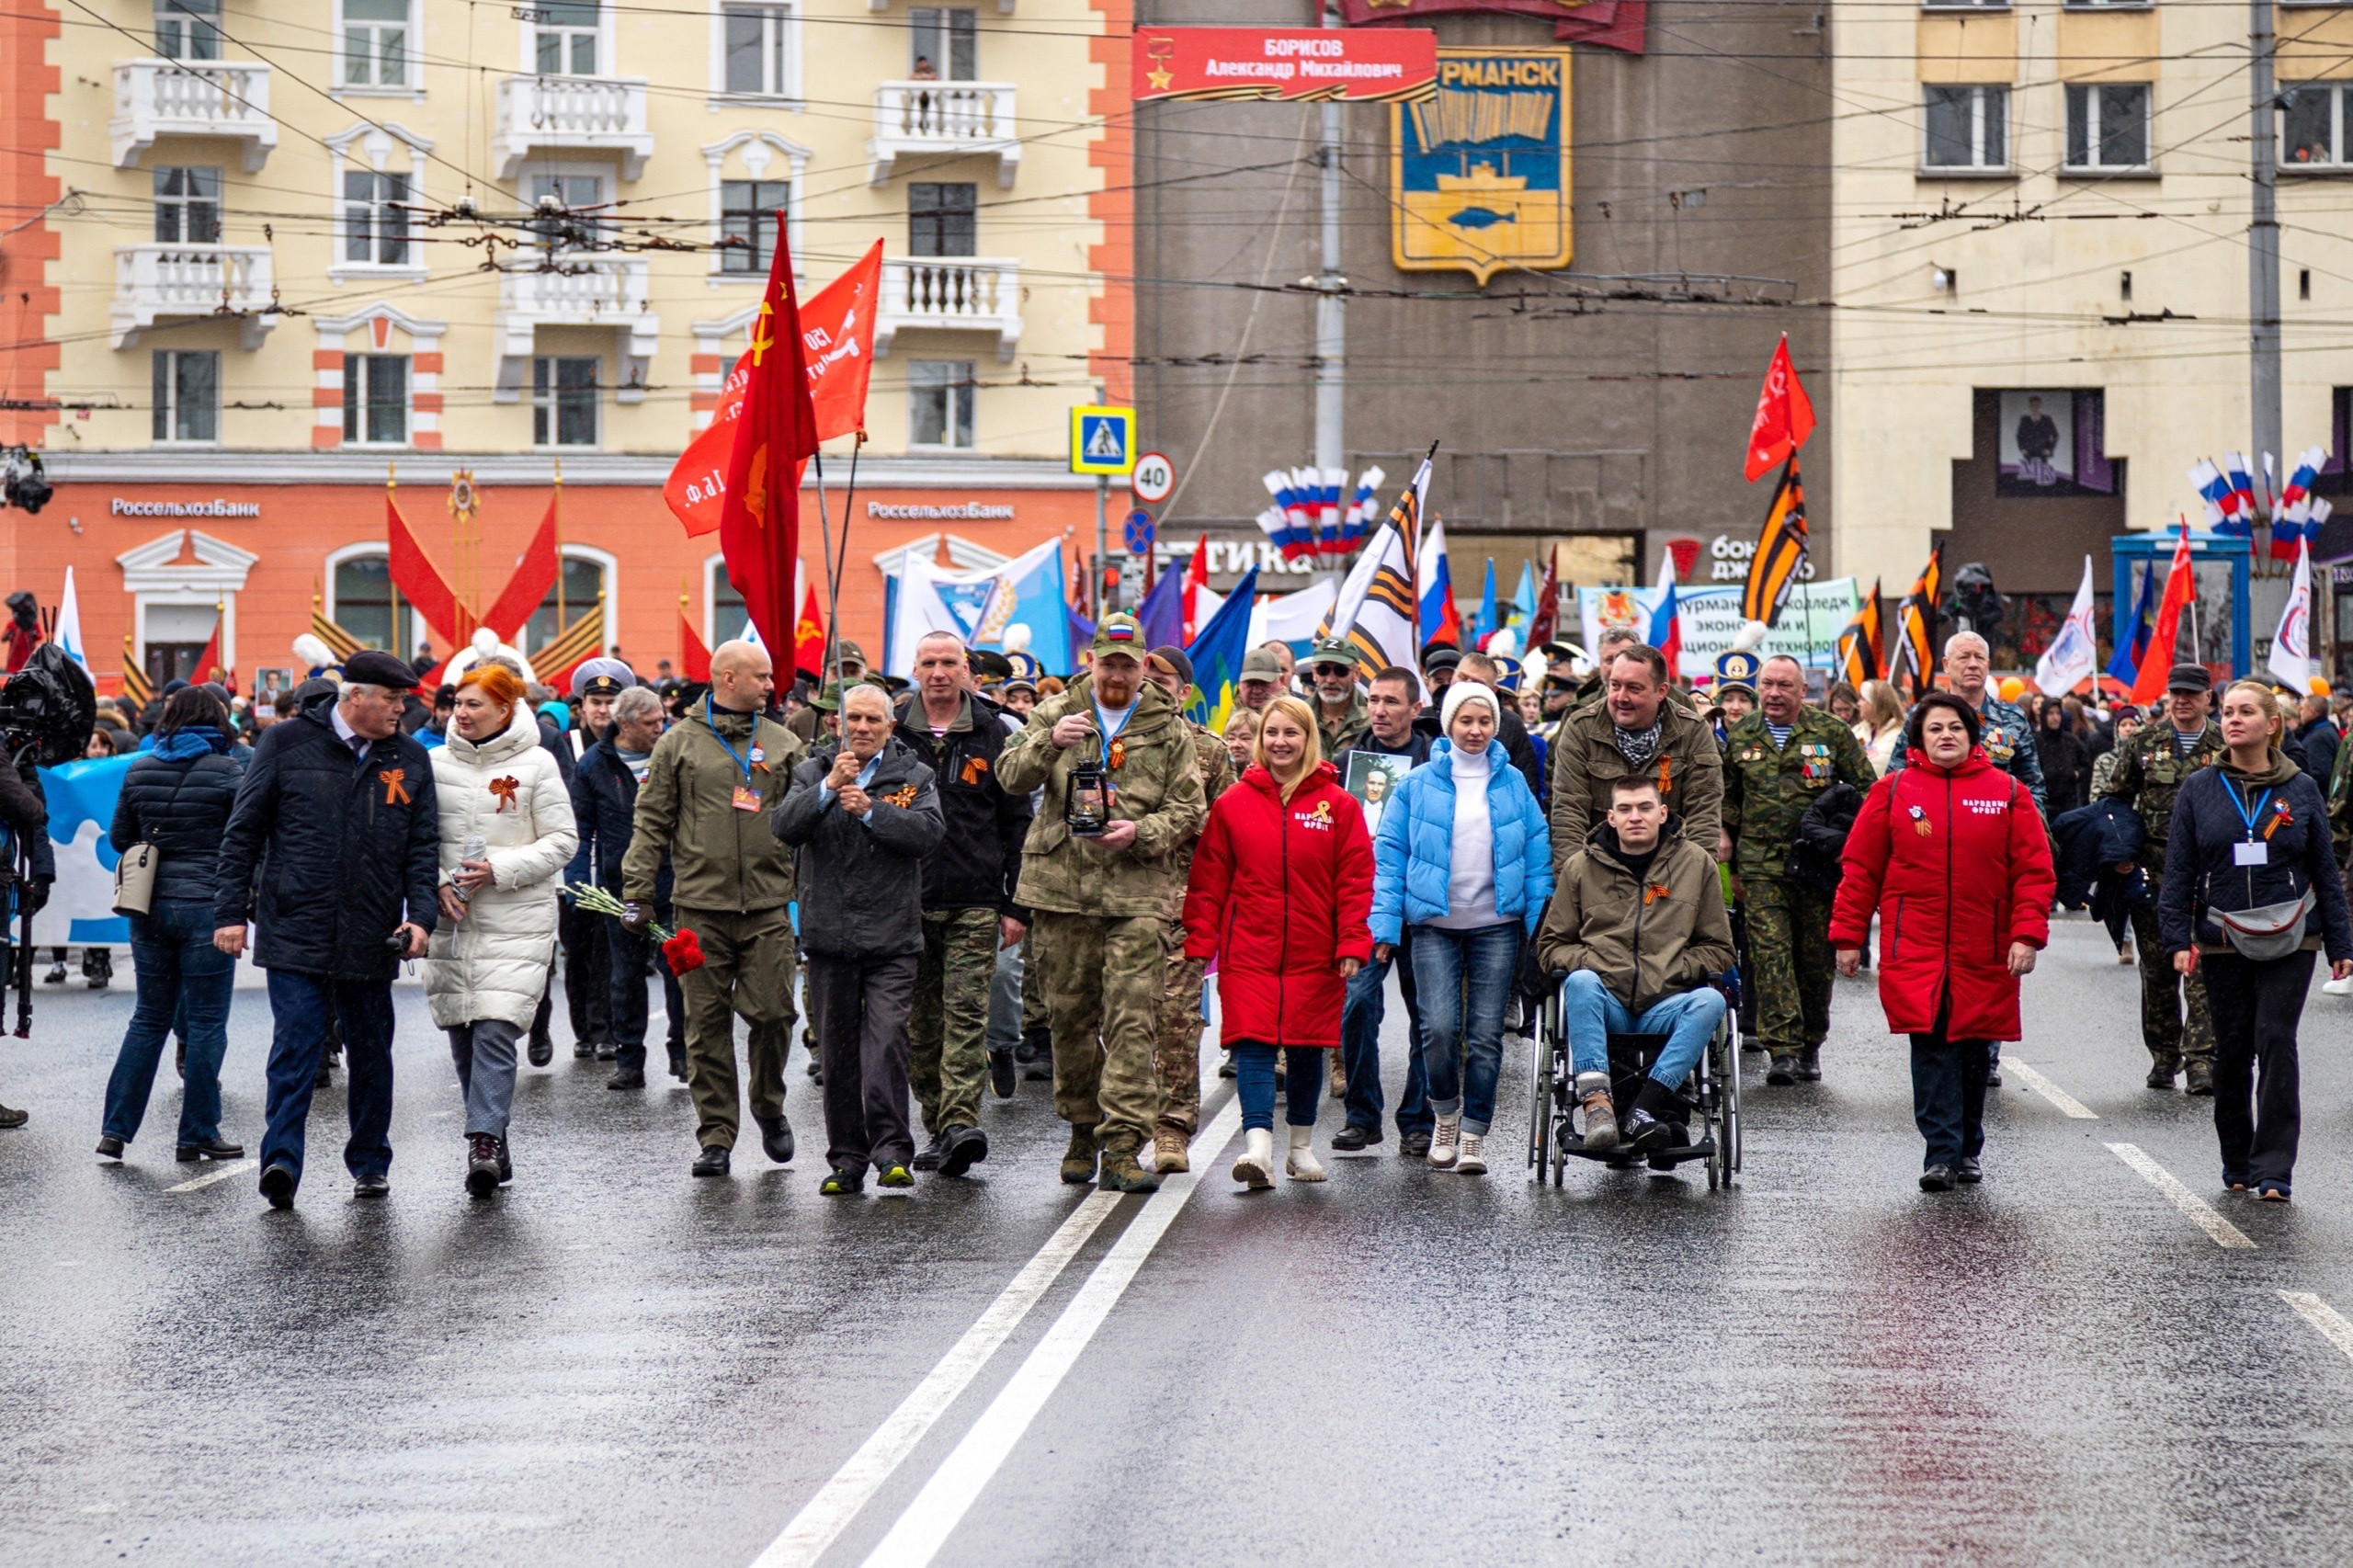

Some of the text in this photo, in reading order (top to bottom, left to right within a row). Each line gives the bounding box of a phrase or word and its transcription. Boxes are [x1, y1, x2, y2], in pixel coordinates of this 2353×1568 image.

[1265, 39, 1344, 57] БОРИСОВ
[1206, 59, 1403, 79] Александр Михайлович
[1140, 467, 1165, 486] 40
[111, 498, 260, 517] РоссельхозБанк
[868, 501, 1015, 519] РоссельхозБанк
[1326, 639, 1339, 649] Z
